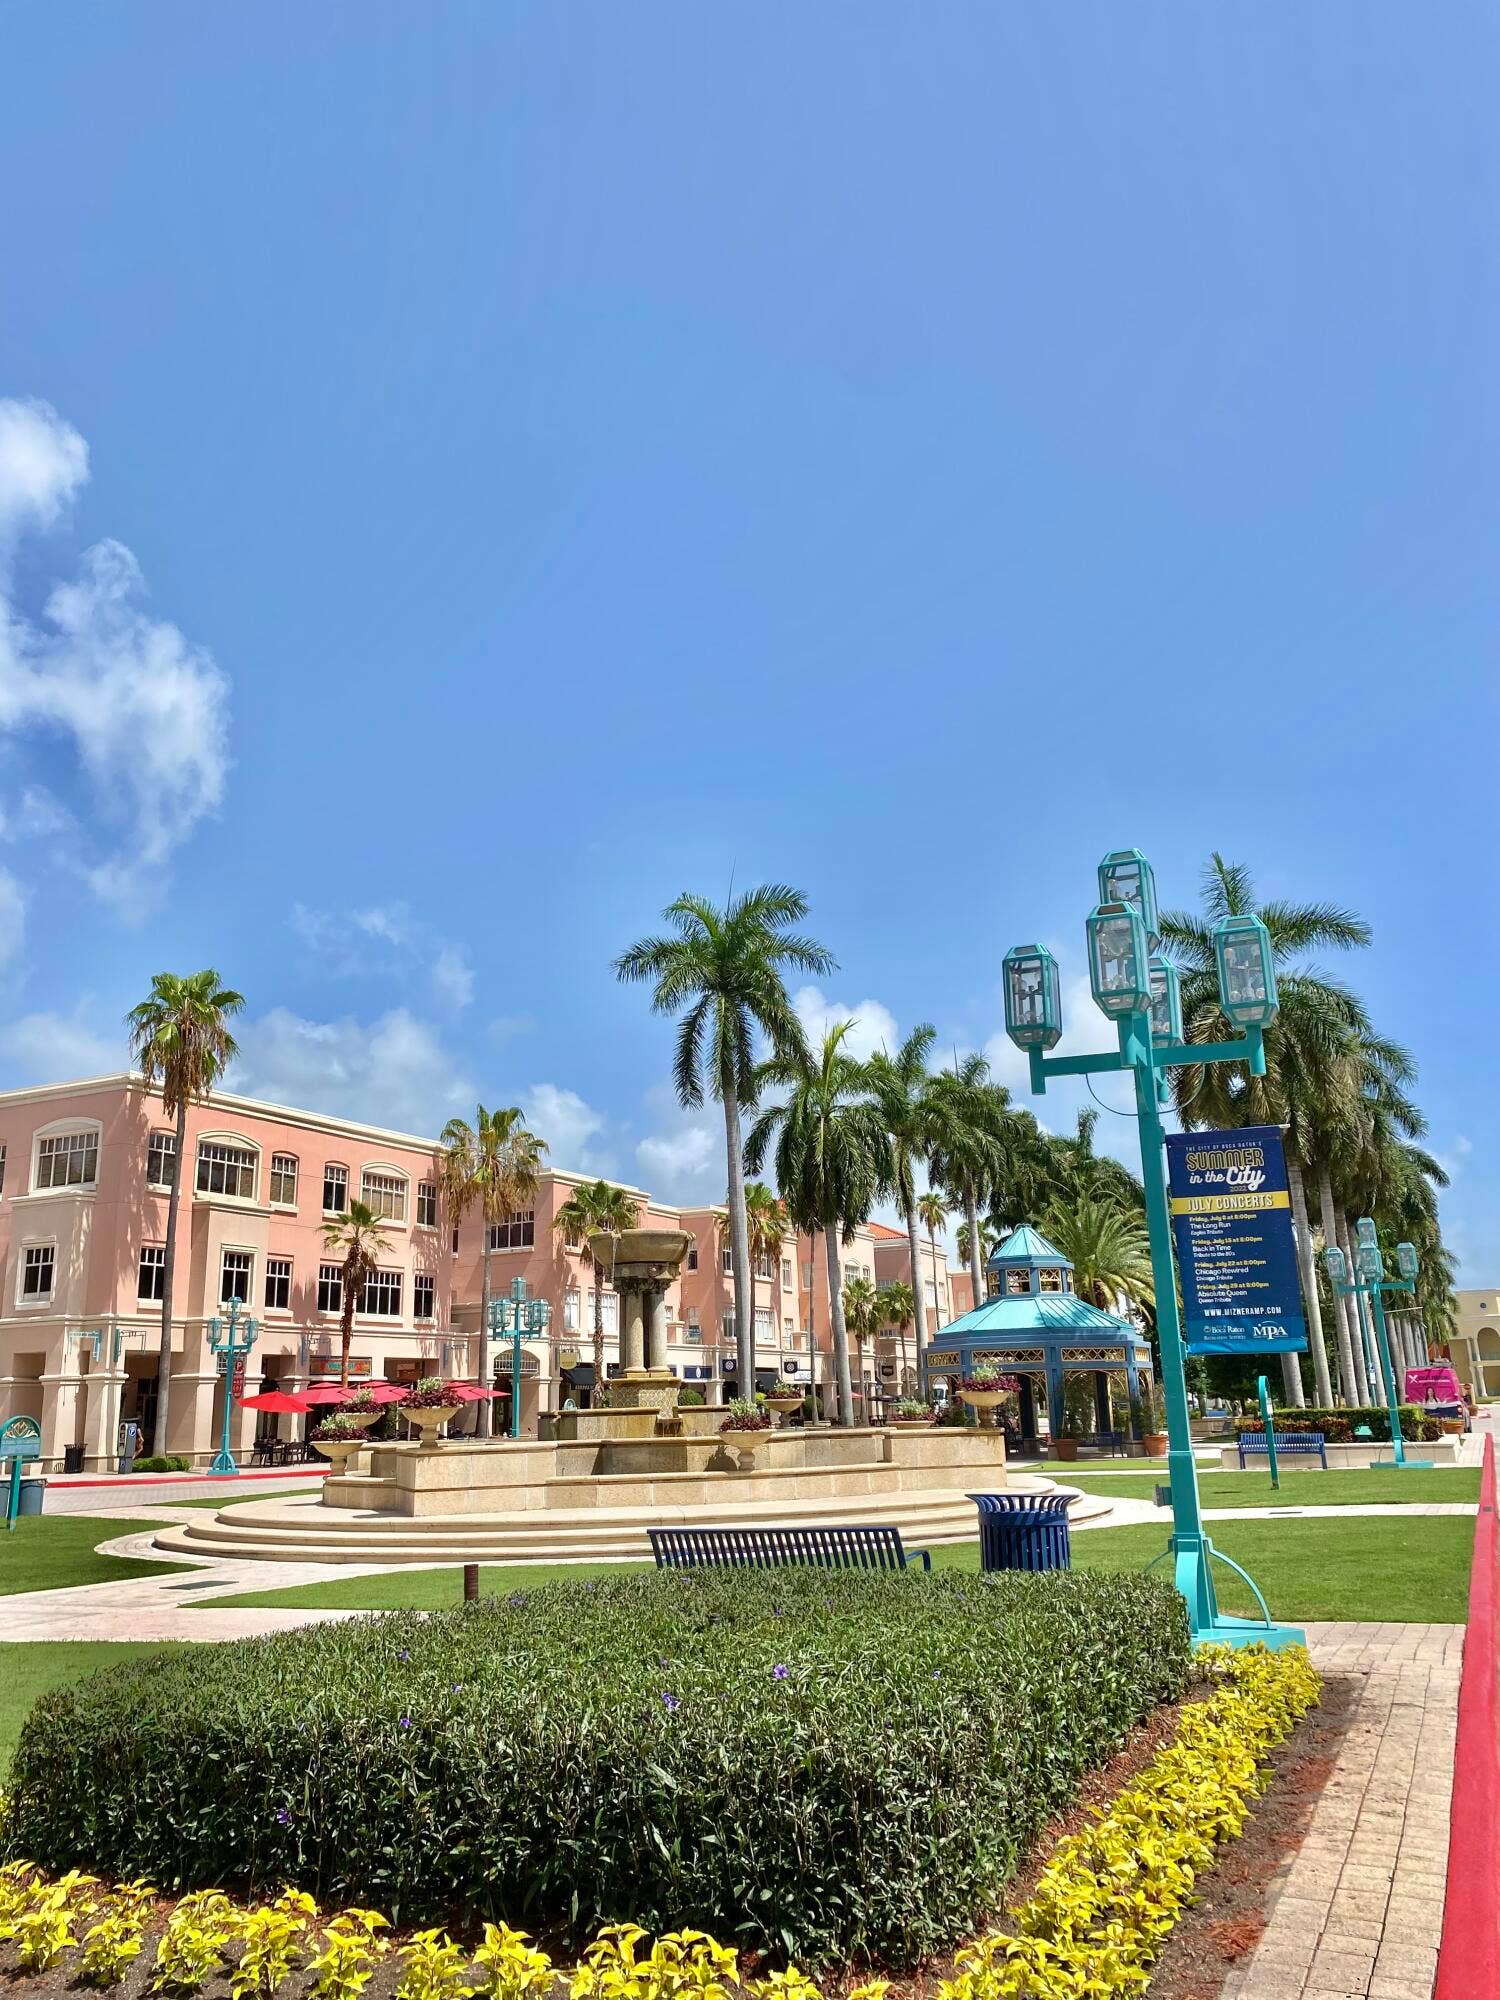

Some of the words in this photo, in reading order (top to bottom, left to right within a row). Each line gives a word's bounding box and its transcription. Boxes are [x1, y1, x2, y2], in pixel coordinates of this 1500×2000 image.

[1186, 1148, 1264, 1171] SUMMER
[1190, 1170, 1203, 1184] in
[1205, 1170, 1225, 1182] the
[1226, 1166, 1265, 1191] City
[1188, 1199, 1215, 1212] JULY
[1216, 1194, 1273, 1209] CONCERTS
[1204, 1307, 1282, 1316] WWW.MIZNERAMP.COM
[1253, 1326, 1288, 1339] MPA
